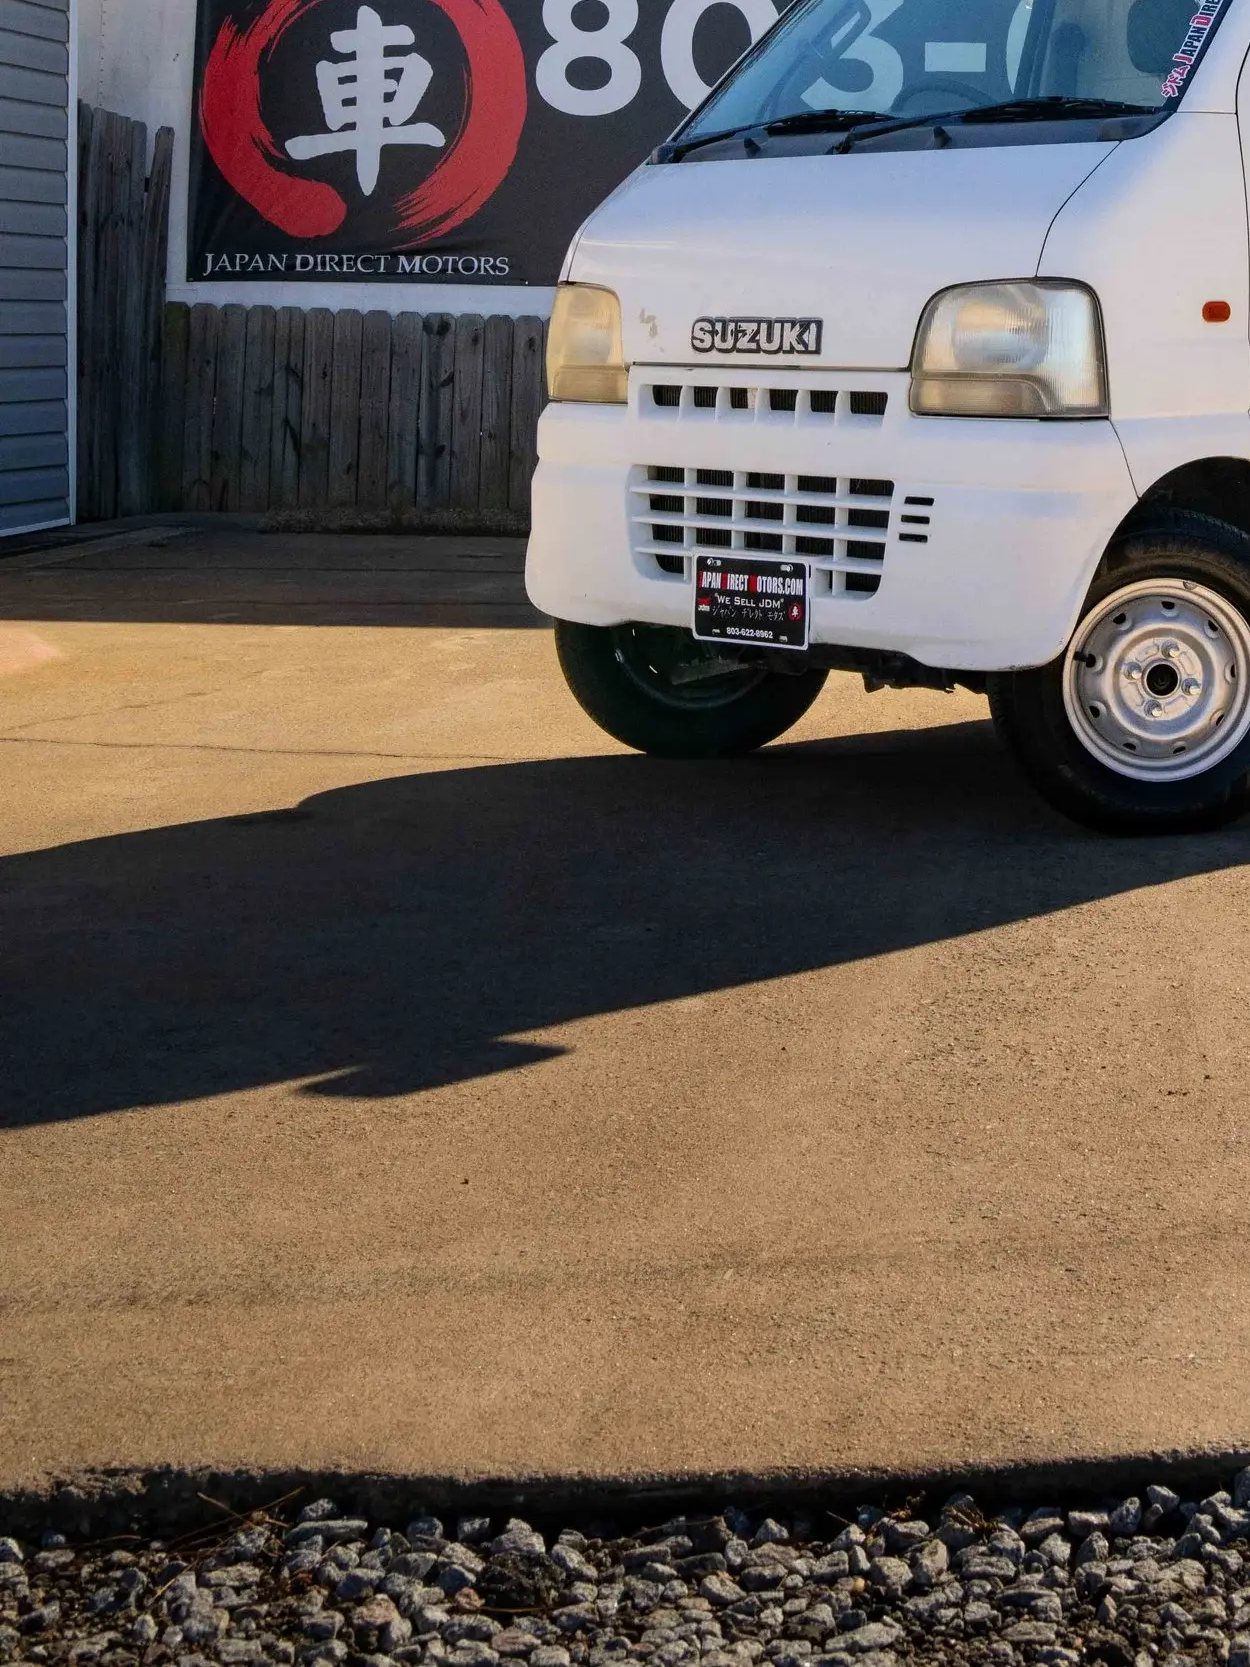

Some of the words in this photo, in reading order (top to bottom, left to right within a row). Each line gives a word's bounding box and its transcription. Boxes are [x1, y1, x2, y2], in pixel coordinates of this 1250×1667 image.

[285, 4, 446, 197] 車
[203, 253, 287, 277] JAPAN
[295, 254, 391, 274] DIRECT
[396, 255, 510, 276] MOTORS
[691, 316, 823, 354] SUZUKI
[726, 626, 774, 639] 803-622-8962
